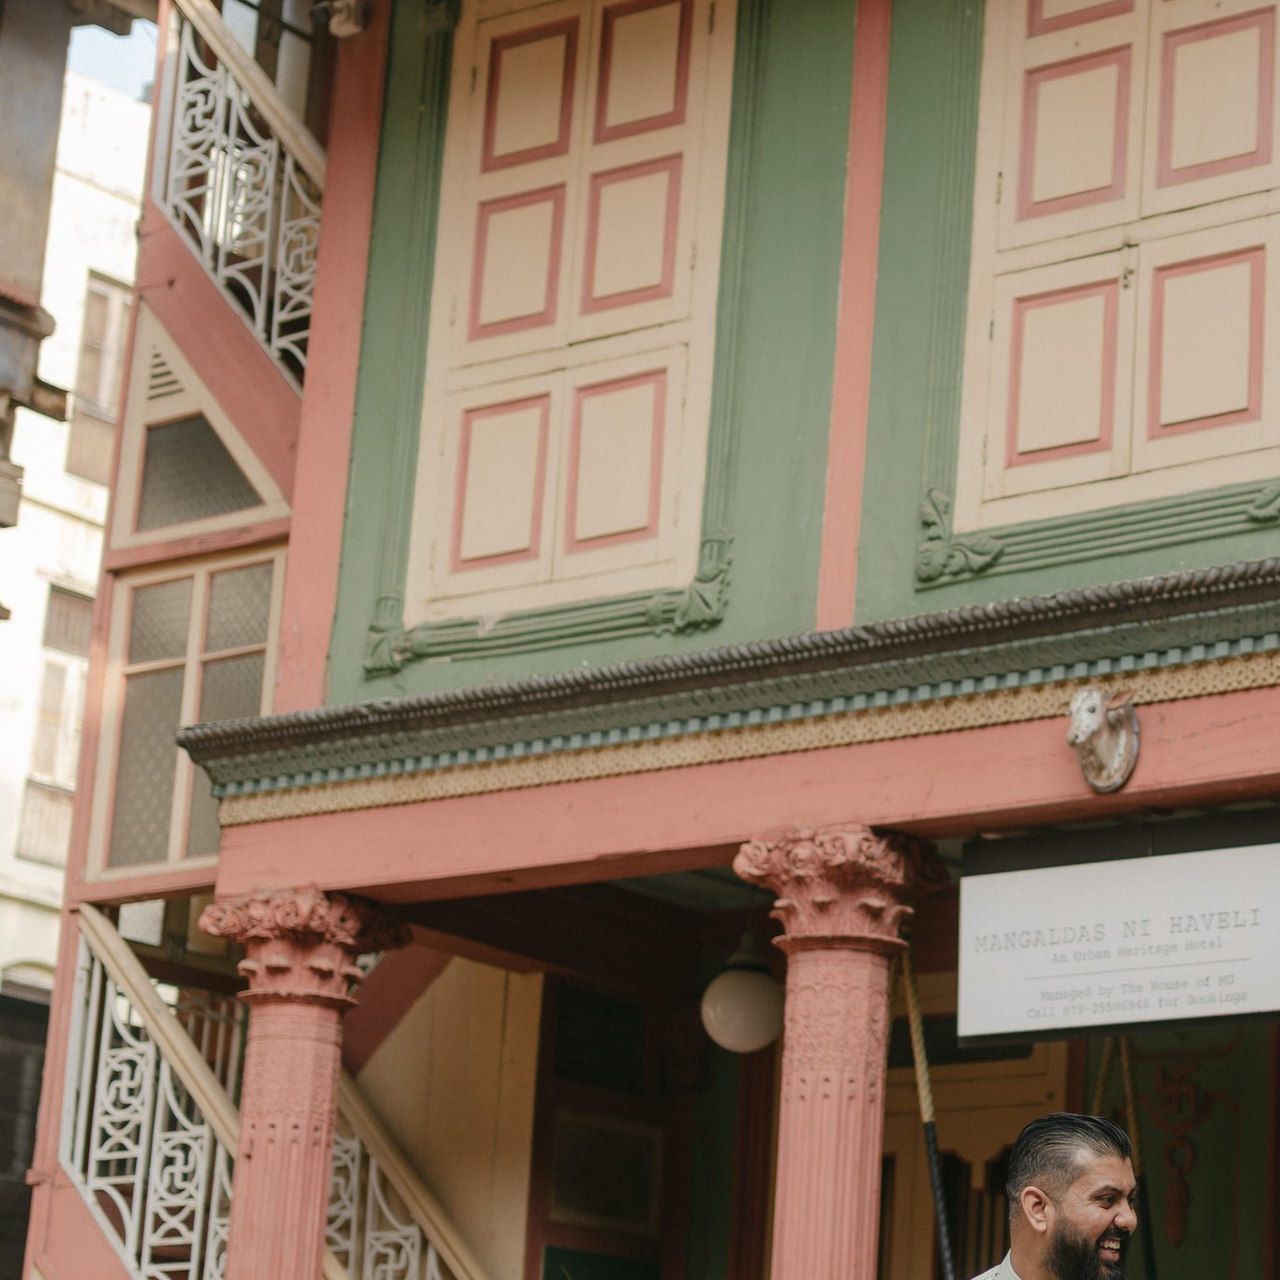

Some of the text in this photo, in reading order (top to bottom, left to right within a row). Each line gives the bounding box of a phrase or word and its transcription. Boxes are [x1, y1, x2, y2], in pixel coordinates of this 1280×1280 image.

[974, 923, 1106, 953] MANGALDAS
[1122, 919, 1151, 938] NI
[1169, 908, 1261, 934] HAVELI
[1051, 937, 1223, 964] An Urban Heritage Hotel
[1040, 974, 1235, 1002] Managed by The House of MG
[1027, 1006, 1055, 1019] Call
[1157, 995, 1180, 1009] for
[1187, 990, 1248, 1006] Bookings
